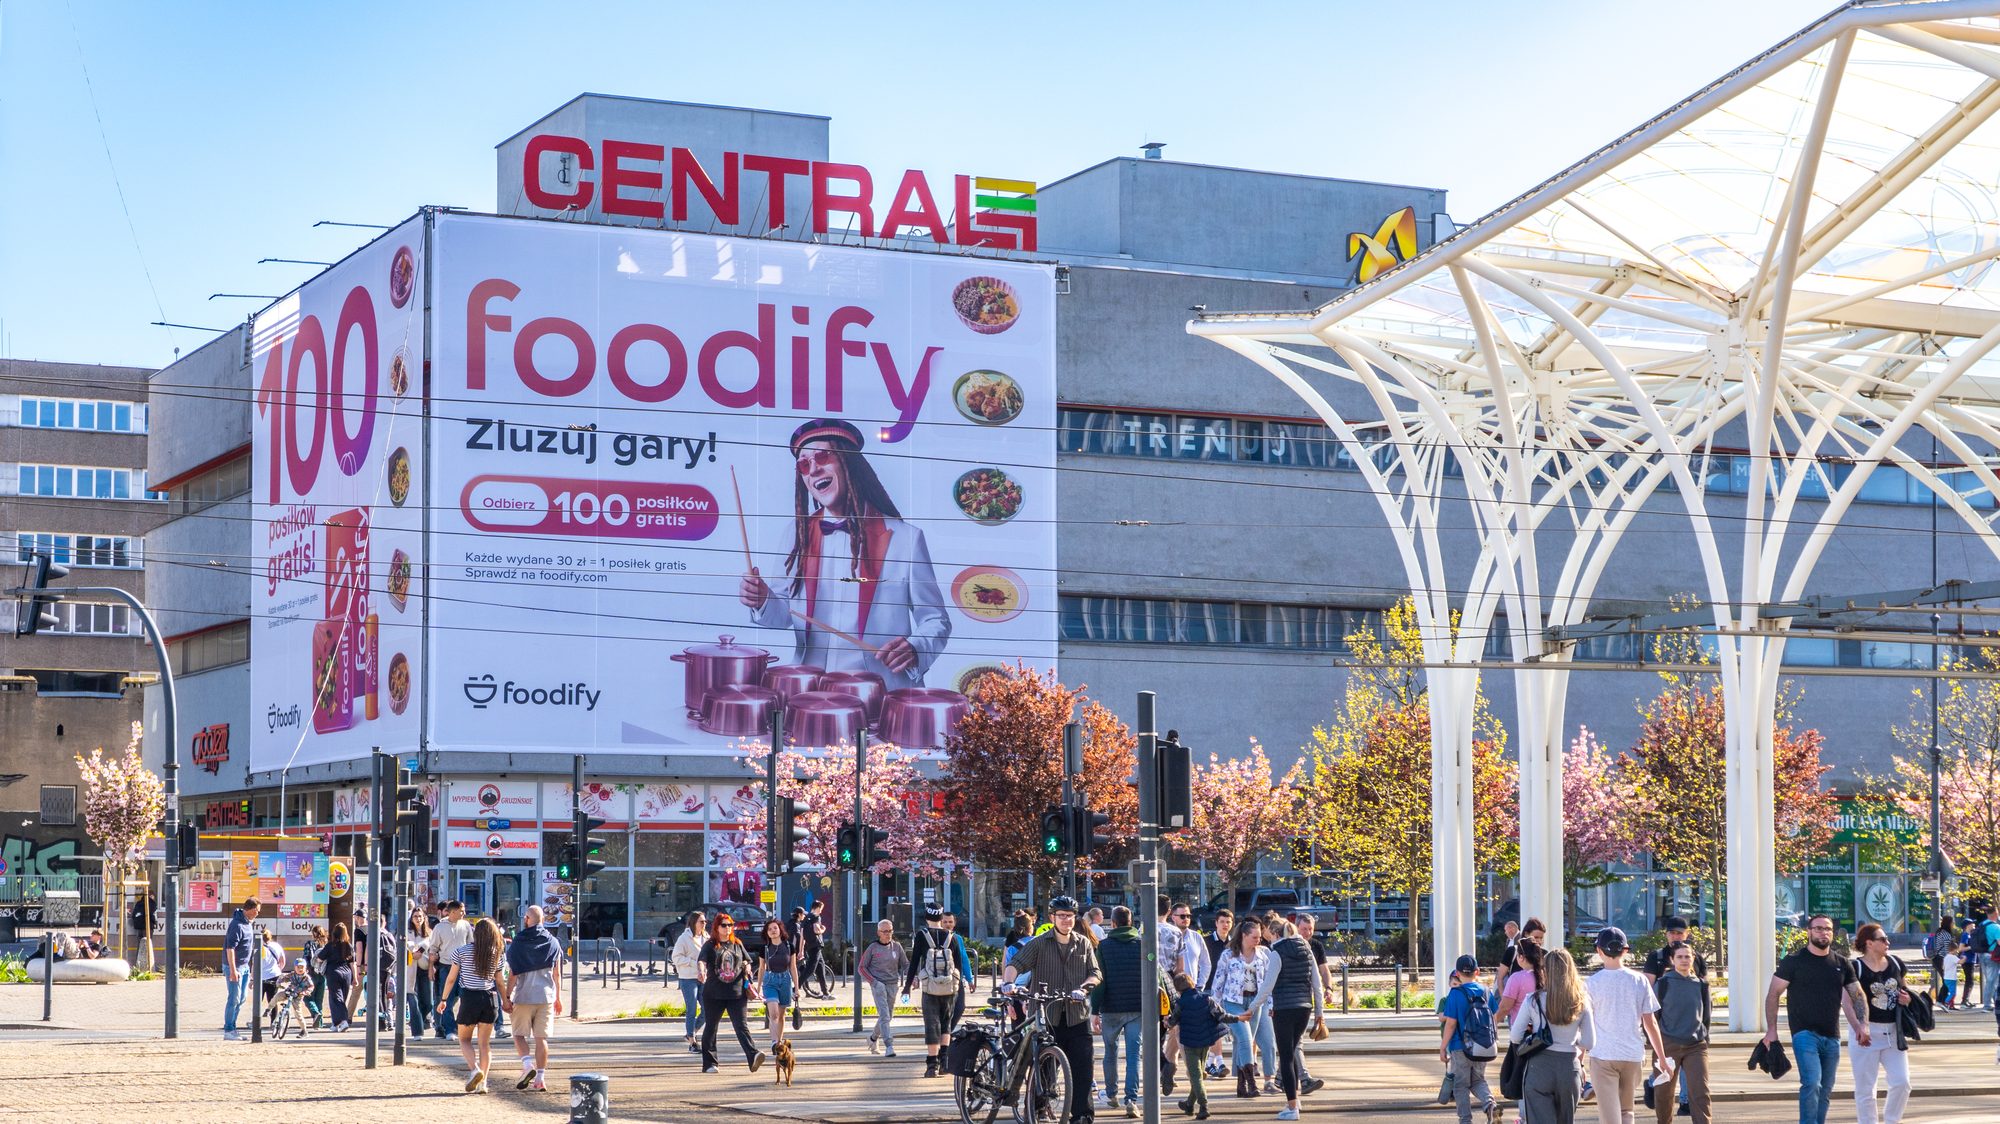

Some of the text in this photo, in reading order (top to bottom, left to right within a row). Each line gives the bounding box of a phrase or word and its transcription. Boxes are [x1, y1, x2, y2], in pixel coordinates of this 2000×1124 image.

[523, 134, 1038, 252] CENTRAL
[468, 278, 945, 443] foodify
[257, 285, 379, 506] 100
[465, 418, 717, 469] Zluzuj gary!
[1123, 420, 1286, 457] TRENUJ
[482, 497, 535, 510] Odbierz
[552, 491, 630, 526] 100
[636, 495, 709, 512] posiłków
[268, 500, 316, 548] posiłków
[636, 513, 687, 528] gratis
[268, 530, 316, 597] gratis!
[465, 552, 502, 564] Każde
[506, 554, 553, 568] wydane
[557, 555, 573, 566] 30
[576, 555, 587, 566] zł
[609, 557, 651, 571] posiłek
[654, 558, 687, 571] gratis
[465, 568, 608, 583] Sprawdź na foodify.com
[502, 681, 601, 711] foodify
[276, 704, 302, 729] foodify
[183, 921, 226, 931] świderki
[291, 921, 314, 932] lody
